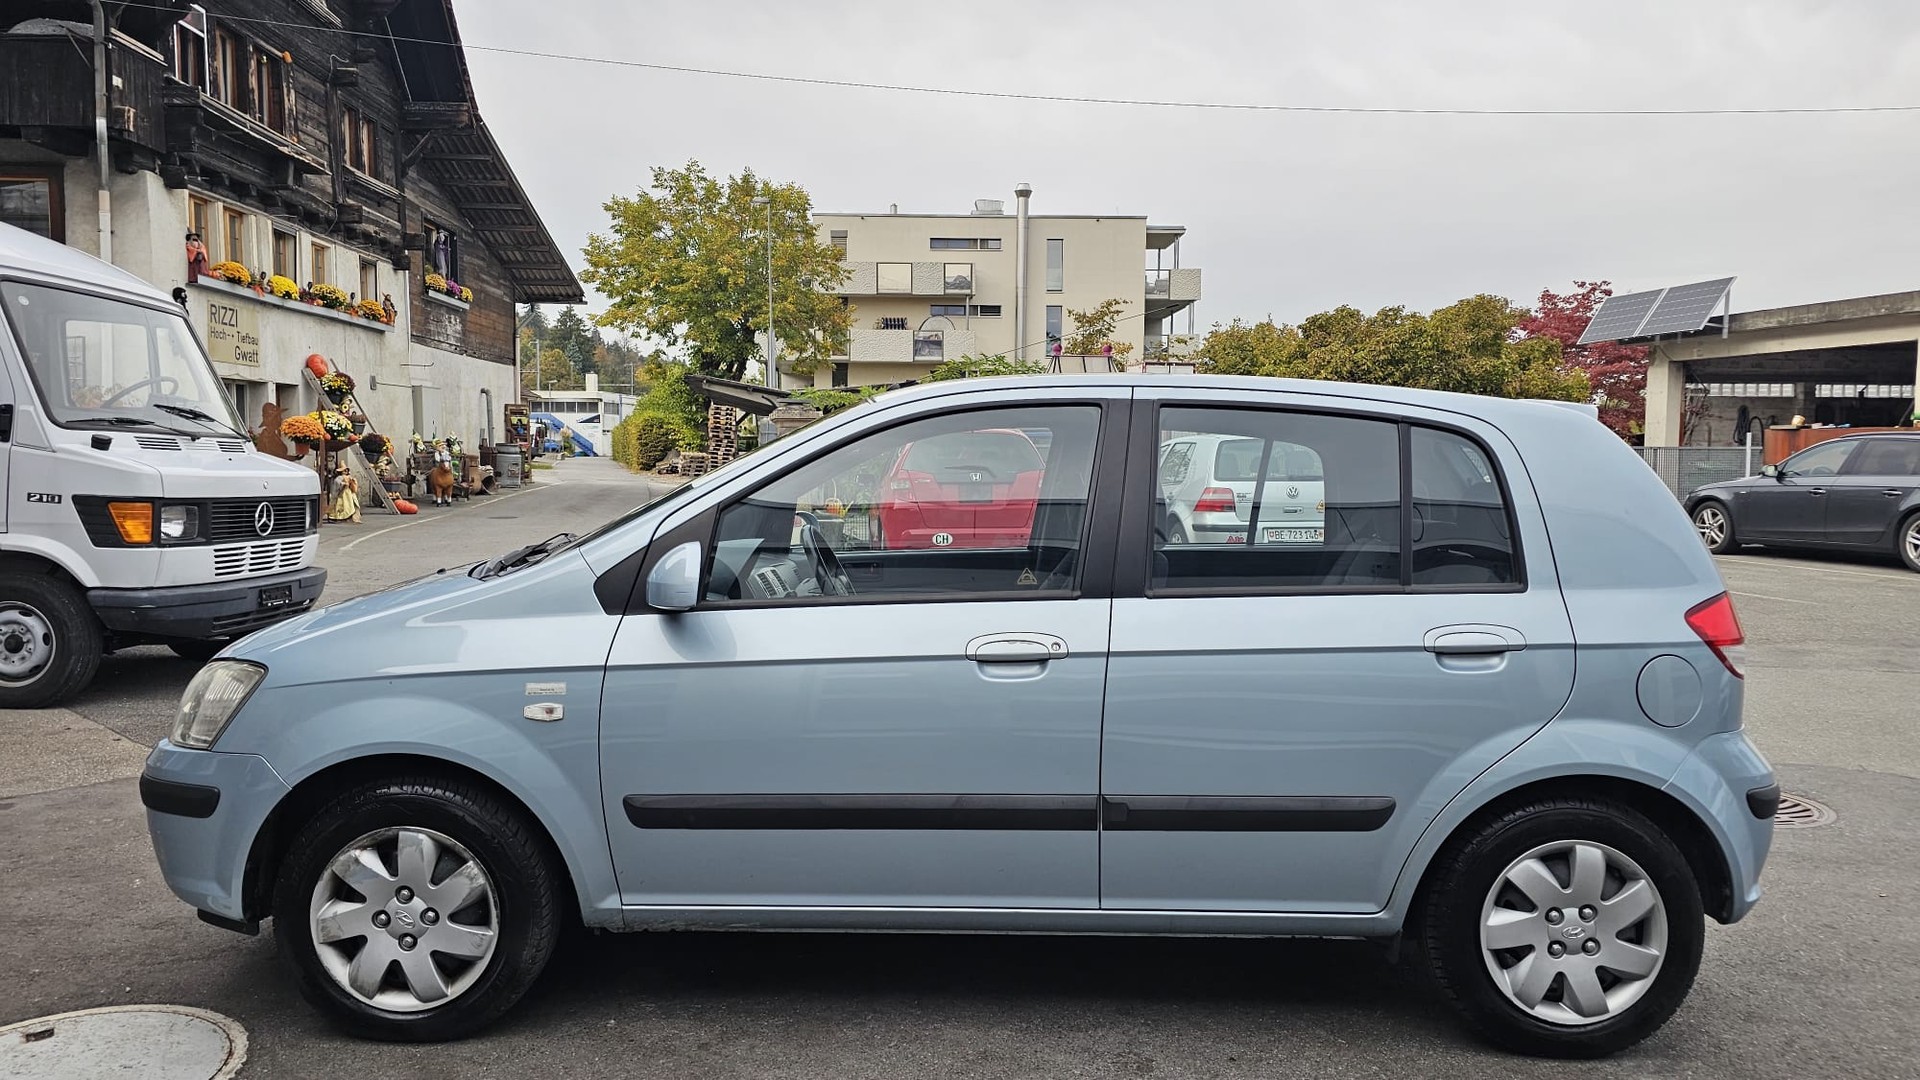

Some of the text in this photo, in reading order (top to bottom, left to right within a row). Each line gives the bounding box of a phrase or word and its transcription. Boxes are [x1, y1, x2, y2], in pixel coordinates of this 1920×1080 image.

[210, 304, 238, 328] RIZZI
[236, 331, 259, 346] Tiefbau
[234, 345, 259, 363] Gwatt
[29, 493, 60, 503] 210
[935, 534, 949, 545] CH
